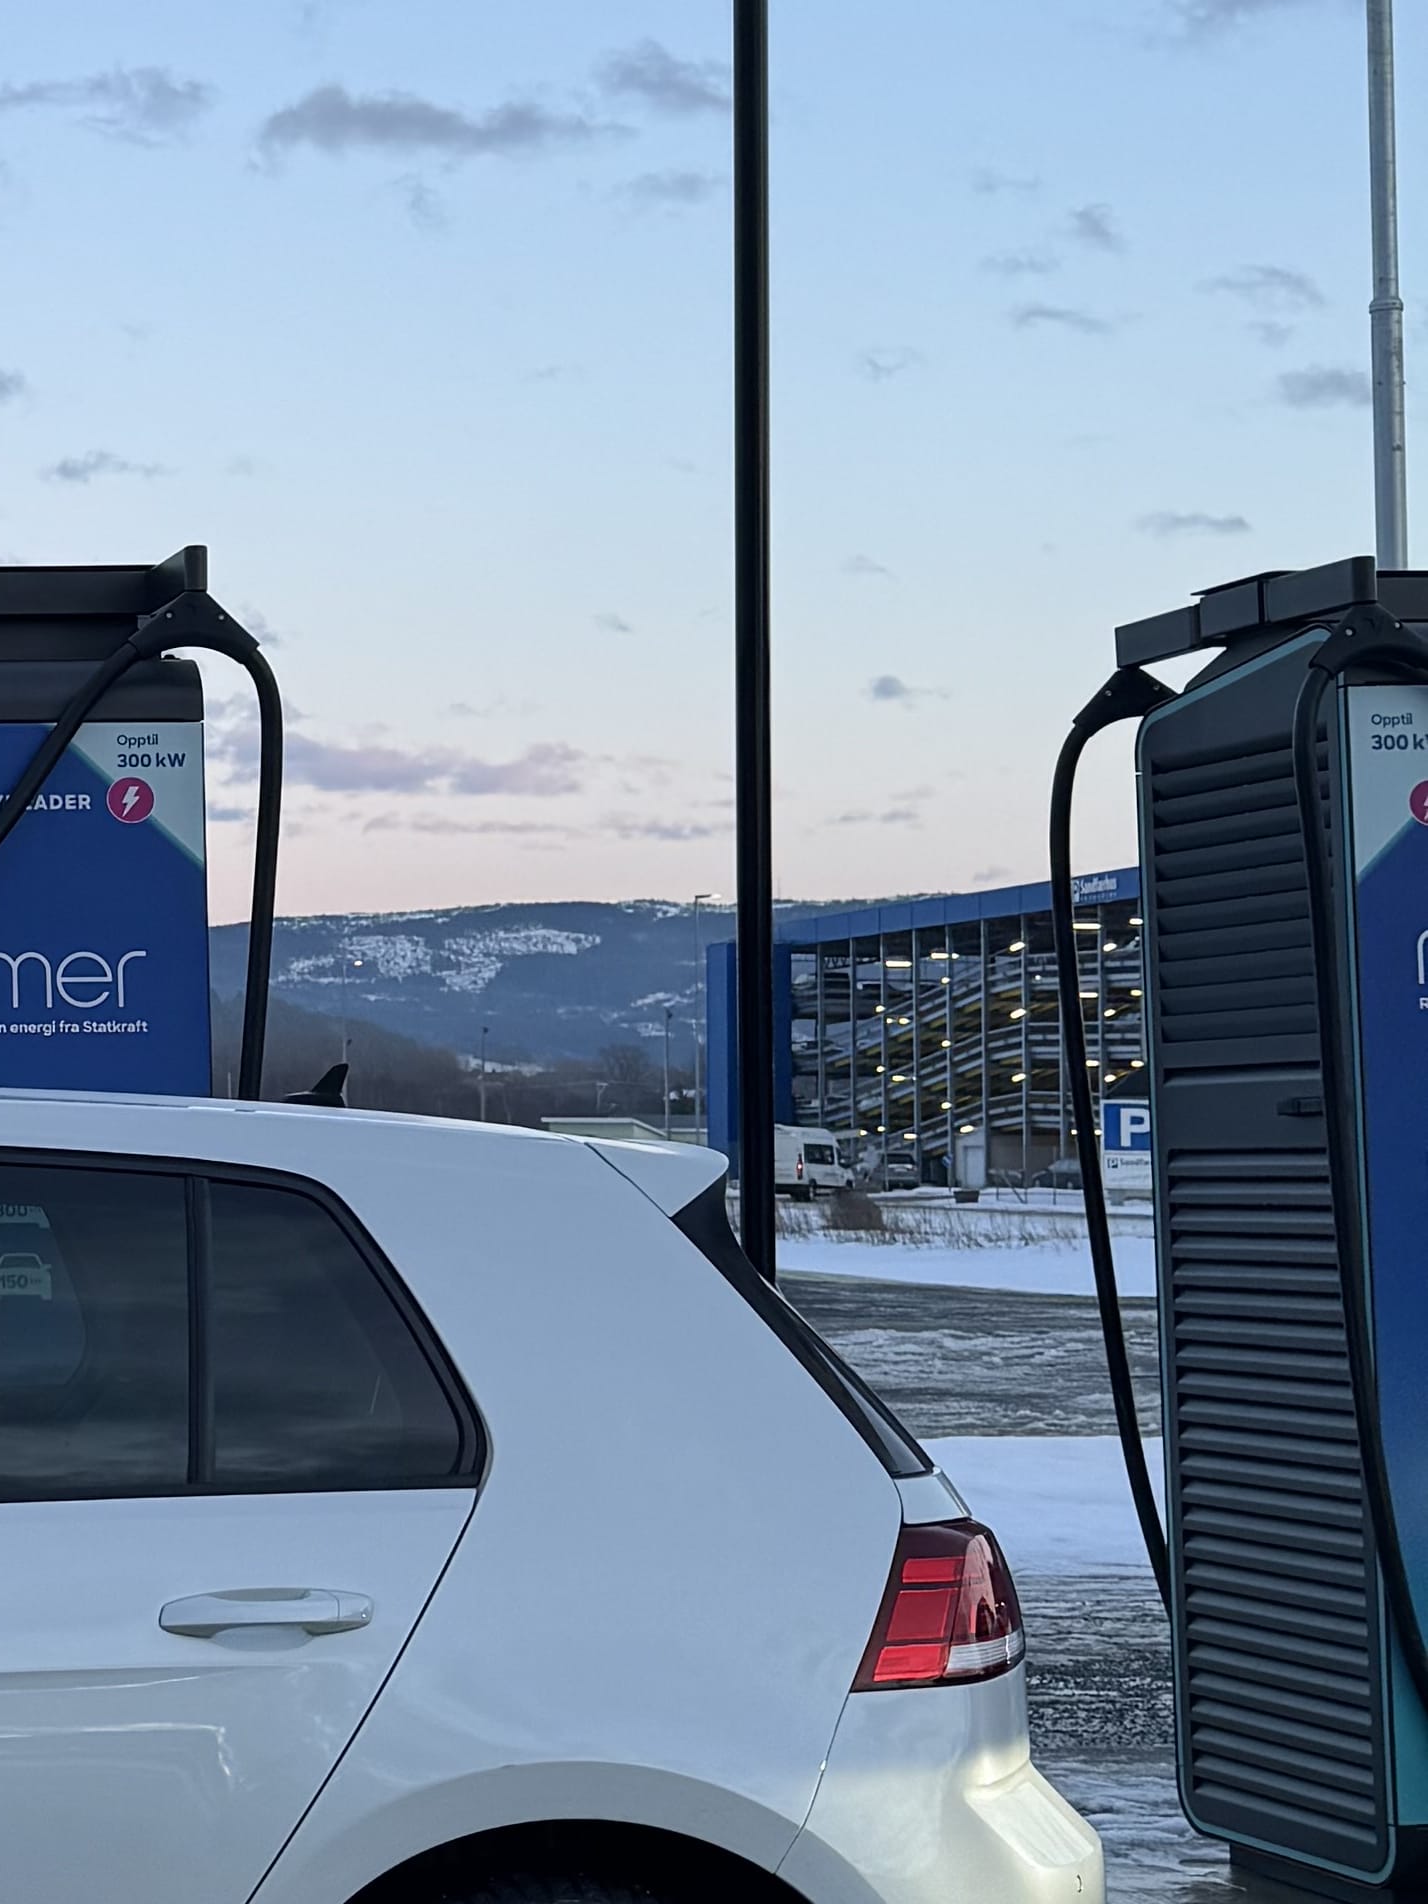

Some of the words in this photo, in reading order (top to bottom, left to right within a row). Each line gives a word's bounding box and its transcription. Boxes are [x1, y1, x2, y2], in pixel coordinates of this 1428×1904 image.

[1370, 712, 1414, 728] Opptil
[116, 733, 159, 748] Opptil
[1371, 734, 1409, 751] 300
[1412, 733, 1428, 750] k
[116, 752, 152, 768] 300
[155, 752, 186, 768] kW
[9, 1020, 56, 1036] energi
[59, 1020, 80, 1033] fra
[82, 1019, 148, 1033] Statkraft
[1119, 1107, 1151, 1147] P
[0, 1274, 29, 1289] 150
